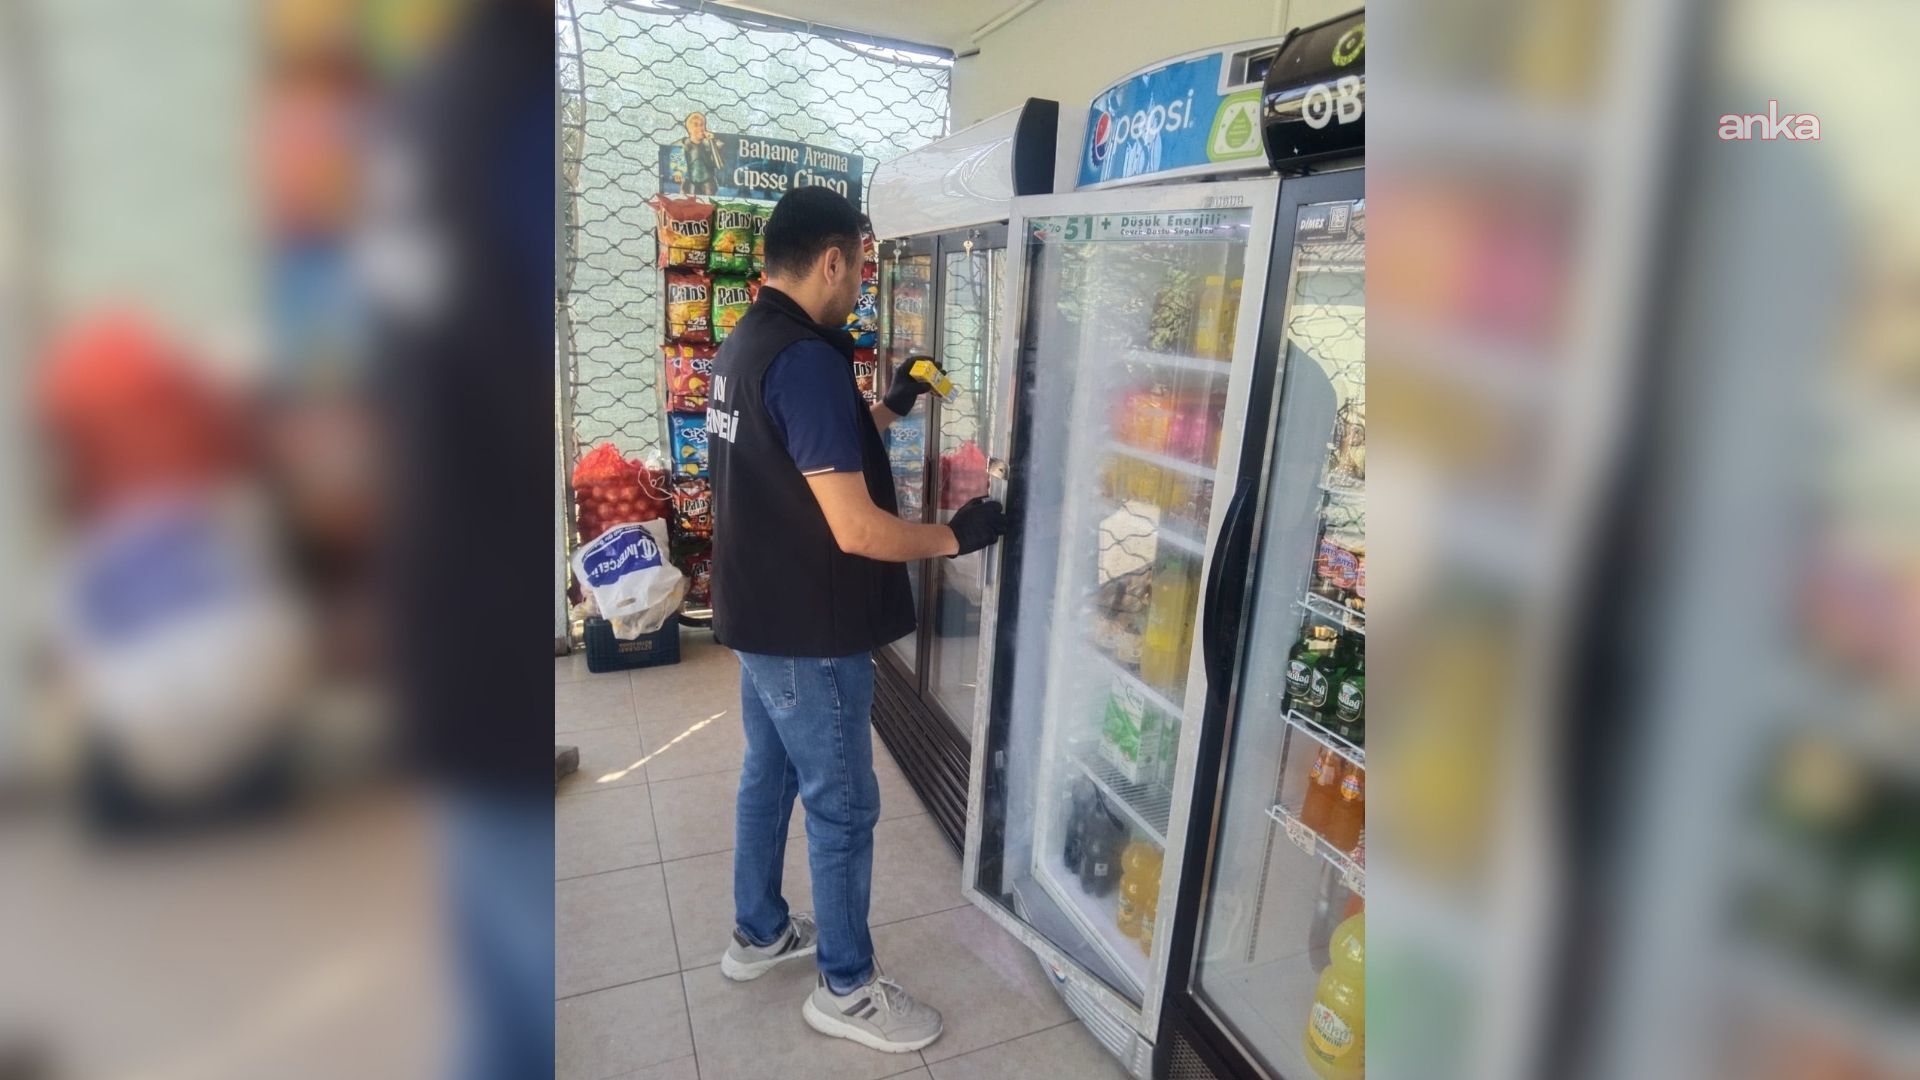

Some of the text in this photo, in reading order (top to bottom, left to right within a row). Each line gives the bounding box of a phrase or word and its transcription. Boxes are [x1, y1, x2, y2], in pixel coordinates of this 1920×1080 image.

[1113, 89, 1195, 149] pepsi
[739, 139, 848, 172] Bahane Arama
[668, 283, 707, 304] Patos
